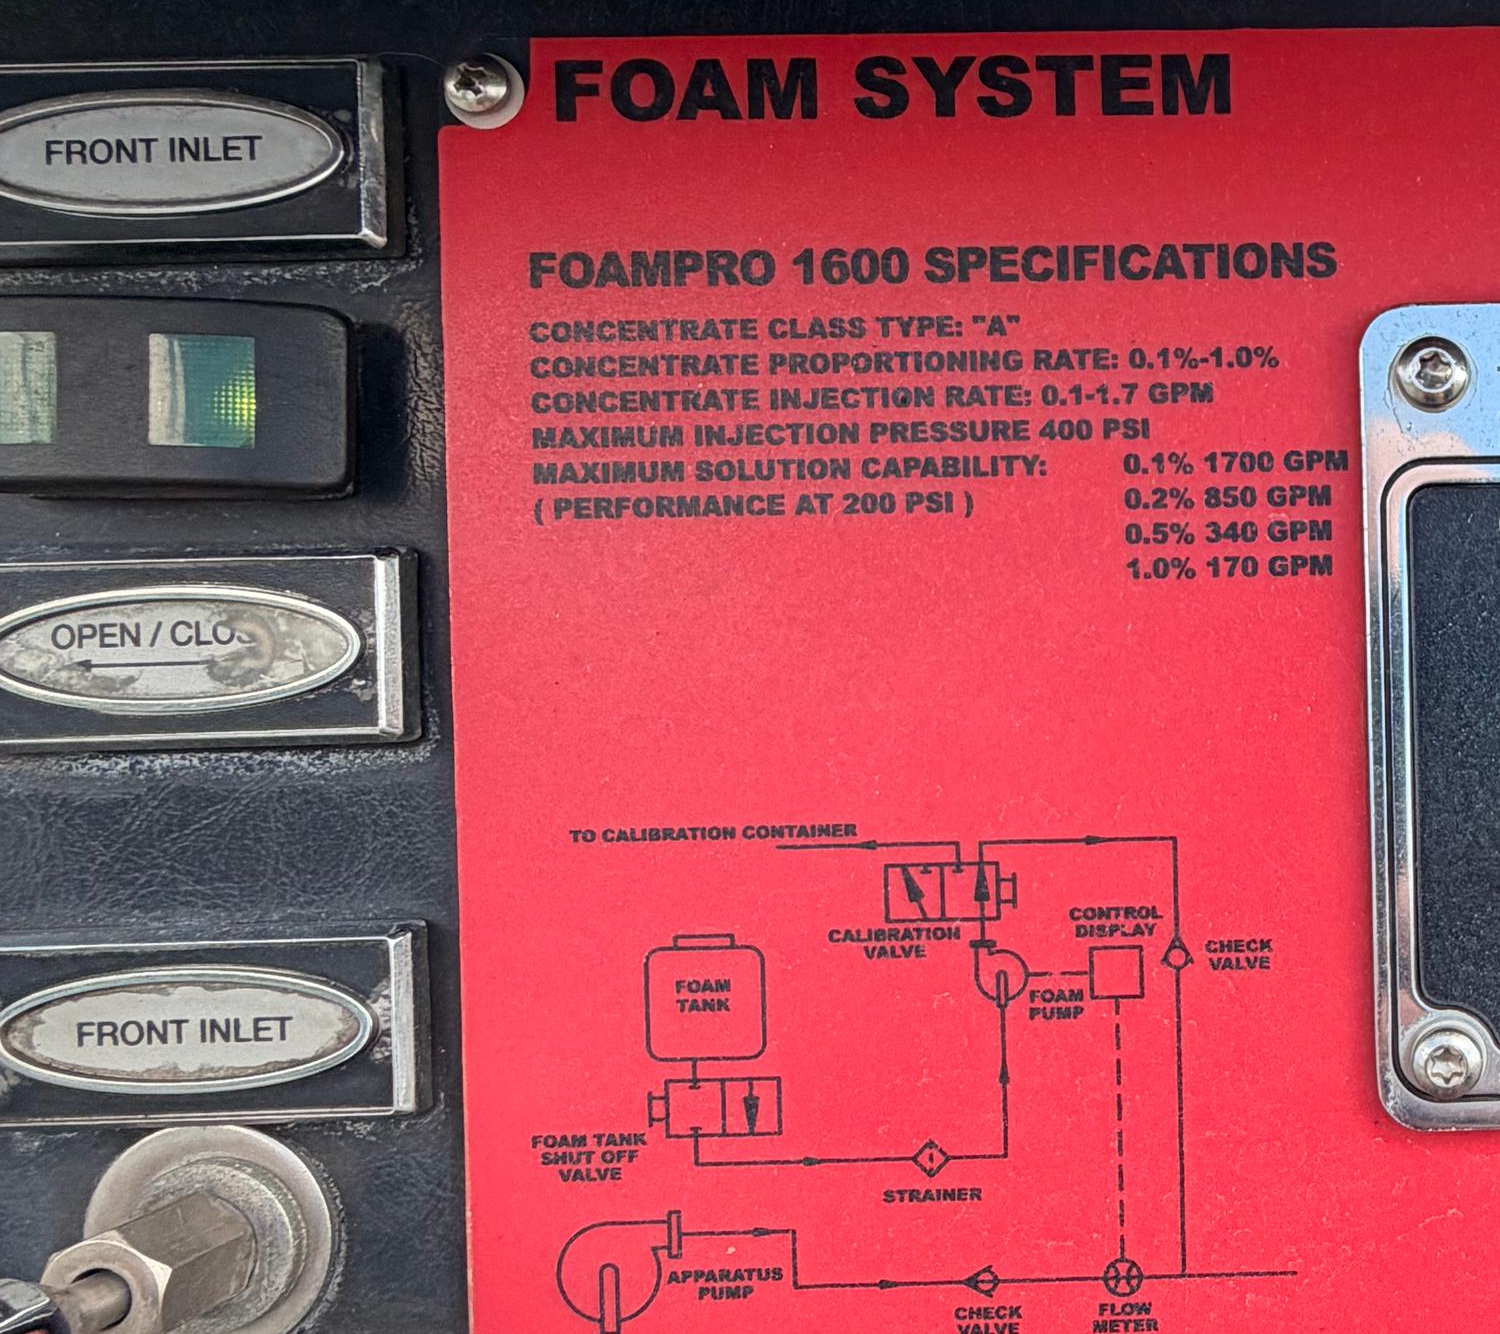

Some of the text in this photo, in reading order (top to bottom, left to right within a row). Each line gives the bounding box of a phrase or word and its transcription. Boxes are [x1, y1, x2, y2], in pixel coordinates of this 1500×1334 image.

[555, 54, 1230, 122] FOAM SYSTEM
[46, 136, 262, 165] FRONT INLET
[529, 242, 1336, 288] FOAMPRO 1600 SPECIFICATIONS
[529, 315, 1020, 343] CONCENTRATE CLASS TYPE: "A"
[530, 346, 1279, 379] CONCENTRATE PROPORTIONING RATE: 0.1%-1.0%
[531, 382, 1213, 413] CONCENTRATE INJECTION RATE: 0.1-1.7 GPM
[533, 419, 1149, 449] MAXIMUM INJECTION PRESSURE 400 PSI
[534, 450, 1348, 484] MAXIMUM SOLUTION CAPABILITY: 0.1% 1700 GPM
[1124, 485, 1331, 510] 0.2% 850 GPM
[554, 494, 784, 520] PERFORMANCE
[795, 493, 833, 515] AT
[843, 493, 895, 514] 200
[906, 492, 953, 513] PSI
[1125, 520, 1332, 544] 0.5% 340 GPM
[1127, 555, 1332, 579] 1.0% 170 GPM
[51, 623, 140, 650] OPEN
[170, 620, 258, 648] CLO
[570, 824, 857, 842] TO CALIBRATION CONTAINER
[1069, 906, 1162, 921] CONTROL
[828, 927, 960, 942] CALIBRATION
[1076, 923, 1155, 938] DISPLAY
[864, 945, 925, 959] VALVE
[1206, 939, 1271, 953] CHECK
[1209, 956, 1269, 970] VALVE
[676, 979, 730, 993] FOAM
[1030, 990, 1083, 1003] FOAM
[677, 999, 729, 1012] TANK
[1029, 1006, 1083, 1020] PUMP
[77, 1017, 293, 1047] FRONT INLET
[532, 1134, 646, 1148] FOAM TANK
[542, 1150, 638, 1165] SHUT OFF
[559, 1168, 621, 1182] VALVE
[883, 1188, 981, 1203] STRAINER
[667, 1268, 783, 1284] APPARATUS
[699, 1286, 753, 1300] PUMP
[955, 1306, 1022, 1320] CHECK
[1099, 1303, 1152, 1316] FLOW
[1093, 1319, 1158, 1333] METER
